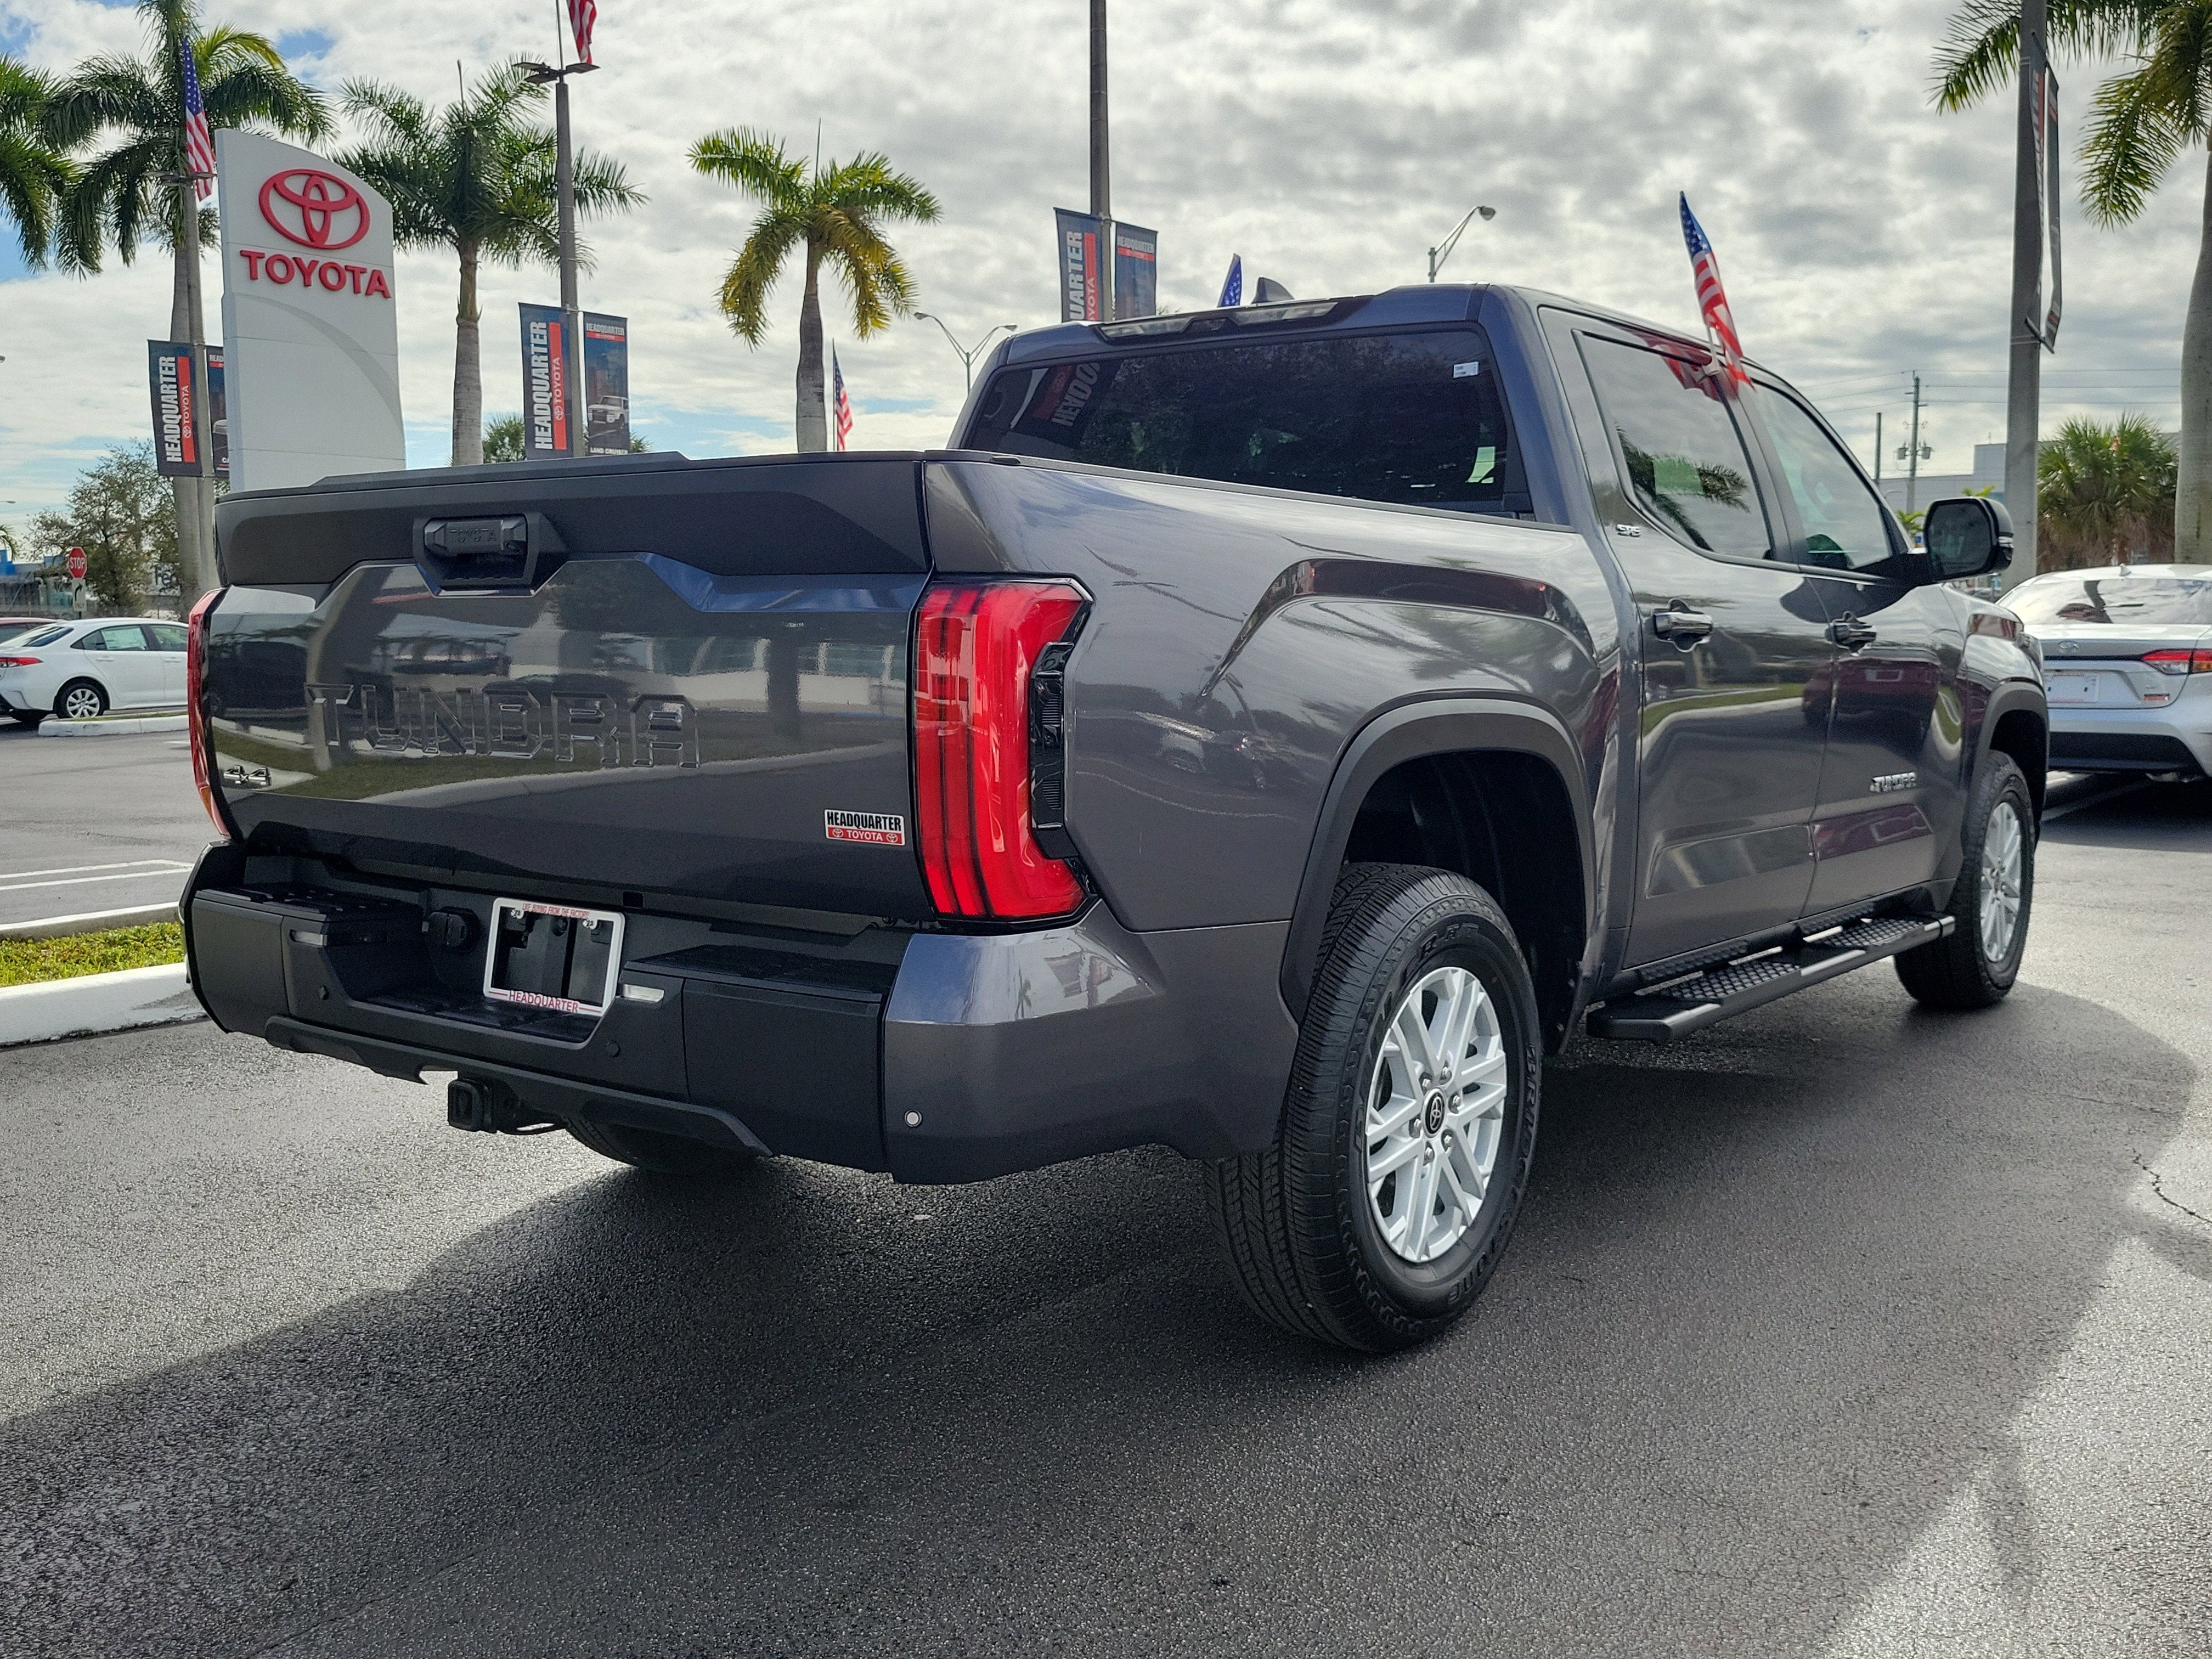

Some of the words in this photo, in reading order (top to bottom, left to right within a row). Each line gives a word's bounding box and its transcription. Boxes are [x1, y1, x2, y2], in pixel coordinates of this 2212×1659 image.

[240, 250, 391, 298] TOYOTA
[1066, 231, 1085, 320] UARTER
[530, 321, 553, 450] HEADQUARTER
[553, 357, 563, 404] TOYOTA
[159, 356, 182, 462] HEADQUARTER
[182, 385, 191, 425] TOYOTA
[70, 557, 85, 569] STOP
[304, 682, 701, 769] TUNDRA
[827, 811, 901, 831] HEADQUARTER
[847, 830, 883, 841] TOYOTA
[509, 991, 579, 1012] HEADQUARTER
